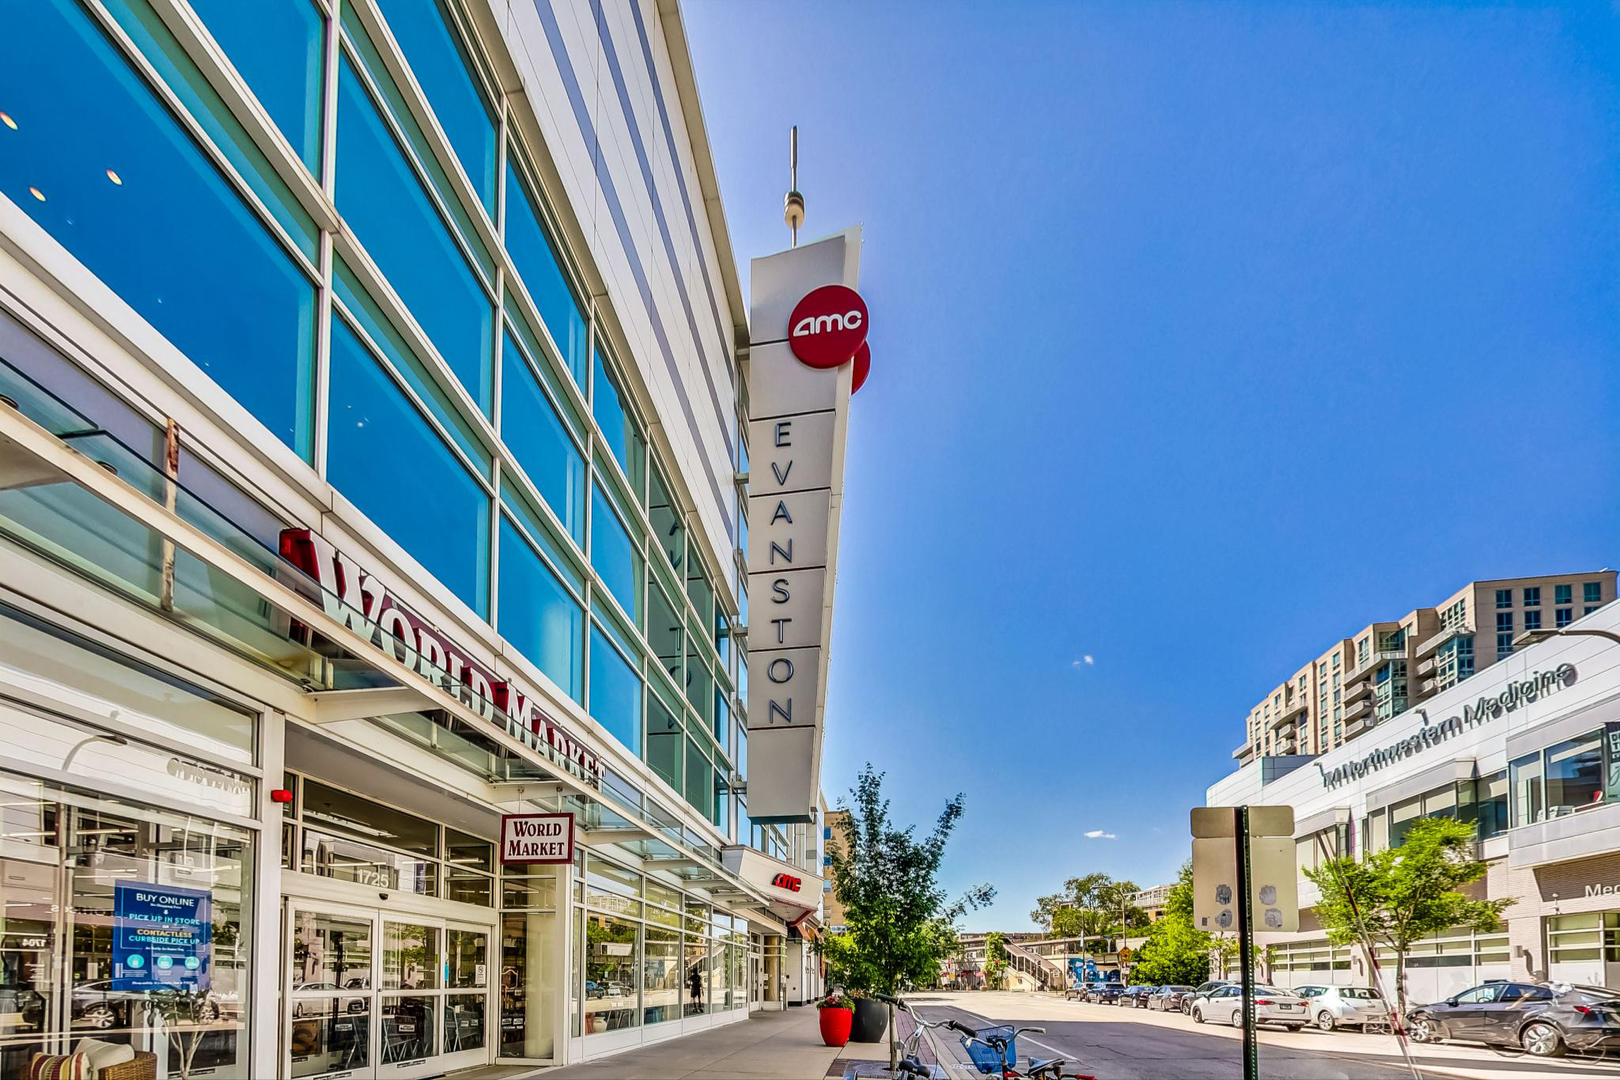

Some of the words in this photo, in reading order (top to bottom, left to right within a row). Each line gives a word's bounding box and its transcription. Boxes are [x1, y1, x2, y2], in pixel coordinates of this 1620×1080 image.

[767, 422, 795, 724] EVANSTON
[304, 529, 495, 723] WORLD
[505, 681, 607, 791] MARKET
[1342, 716, 1462, 780] Northwestern
[1463, 663, 1577, 727] Medicine
[513, 821, 562, 837] WORLD
[508, 840, 564, 856] MARKET
[358, 869, 389, 888] 1725
[136, 893, 157, 902] BUY
[159, 896, 195, 907] ONLINE
[129, 913, 149, 921] PICK
[174, 917, 200, 925] STORE
[128, 935, 170, 943] CURBSIDE
[137, 929, 192, 938] CONTACTLESS
